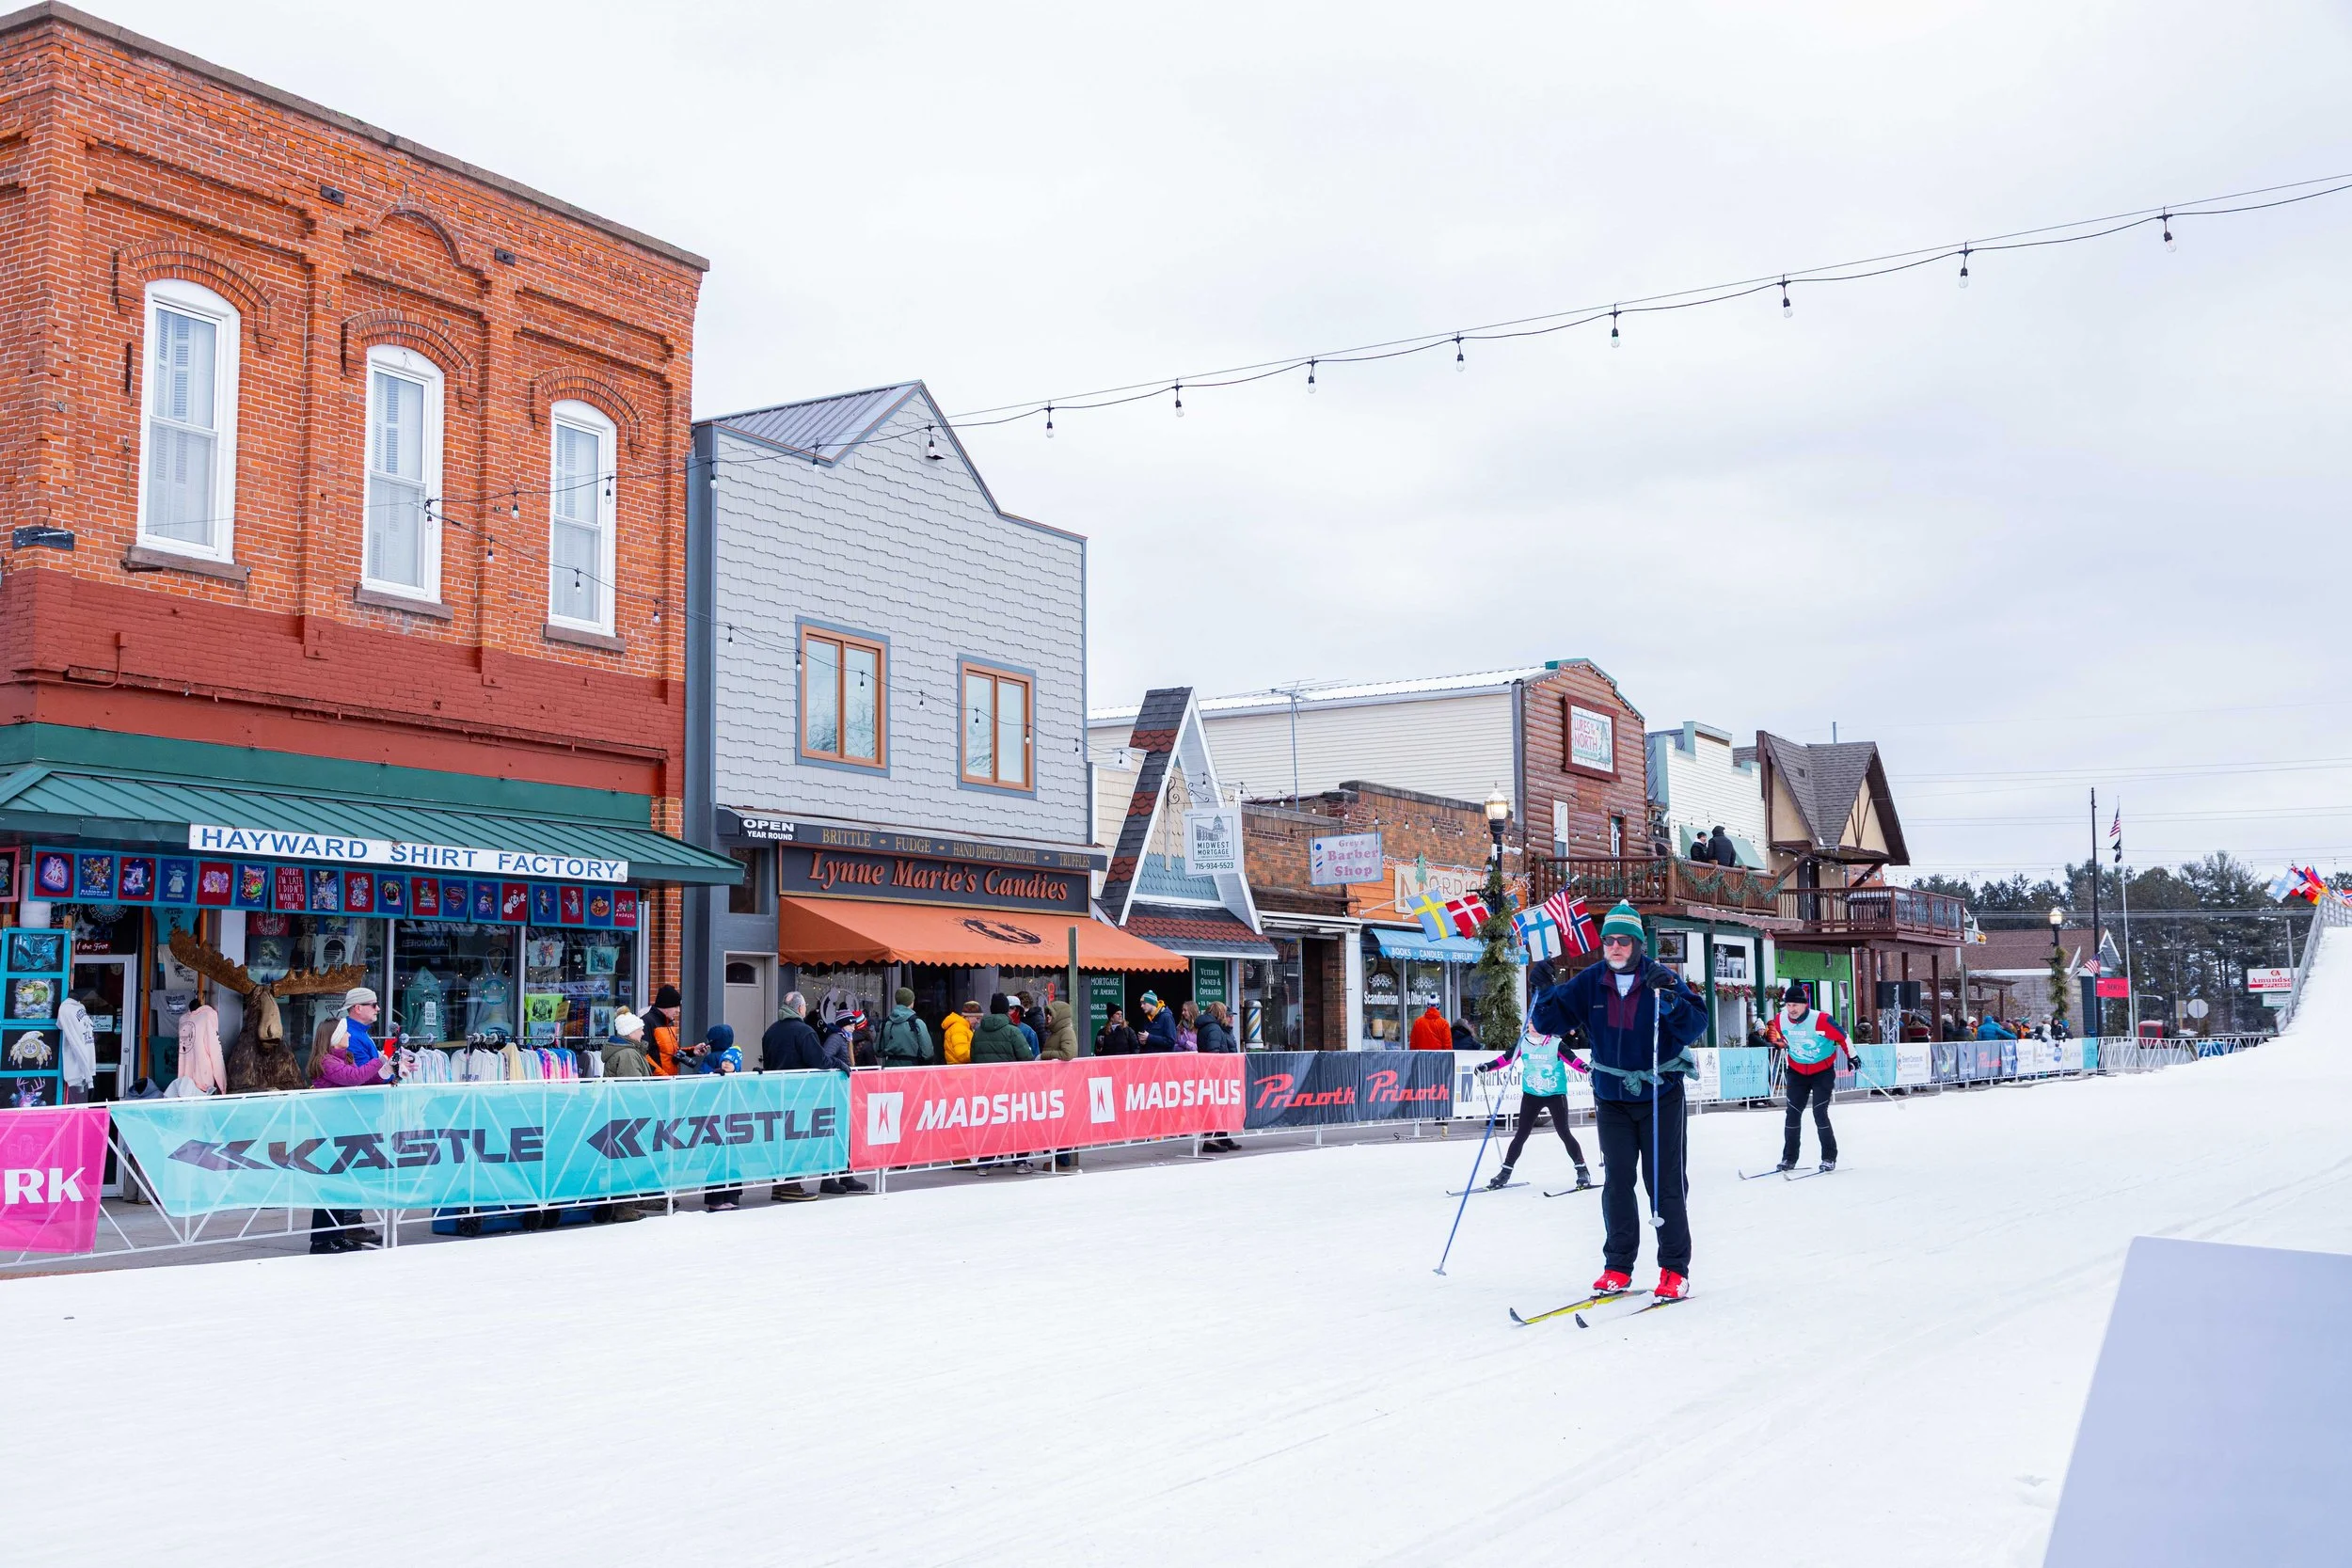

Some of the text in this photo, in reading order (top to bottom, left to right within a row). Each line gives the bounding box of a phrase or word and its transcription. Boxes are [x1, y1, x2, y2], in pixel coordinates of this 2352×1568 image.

[1575, 734, 1597, 752] NORTH
[743, 818, 795, 832] OPEN
[747, 831, 793, 841] YEAR ROUND
[201, 828, 619, 879] HAYWARD SHIRT FACTORY
[821, 829, 1090, 868] BRITTLE FUDGE HAND DIPPED CHOCOLATE TRUFFLES
[1327, 848, 1378, 862] Barber
[282, 867, 299, 876] SORRY
[809, 852, 1068, 900] Lynne Marie's Candies
[1334, 865, 1373, 878] Shop
[278, 876, 304, 885] I'M LATE
[284, 885, 303, 894] DIDN'T
[279, 894, 305, 902] WANT TO
[1391, 947, 1473, 960] BOOKS CANDLES JEWELRY
[1090, 977, 1120, 986] MORTGAGE
[1364, 991, 1399, 1006] Scandinavian
[1411, 991, 1422, 1005] Other
[1253, 1073, 1355, 1109] Prinoth
[1366, 1069, 1449, 1102] Prinoth
[1125, 1079, 1241, 1112] MADSHUS
[916, 1088, 1064, 1131] MADSHUS
[653, 1107, 835, 1152] KASTLE
[268, 1126, 544, 1174] KASTLE
[5, 1166, 86, 1205] RK
